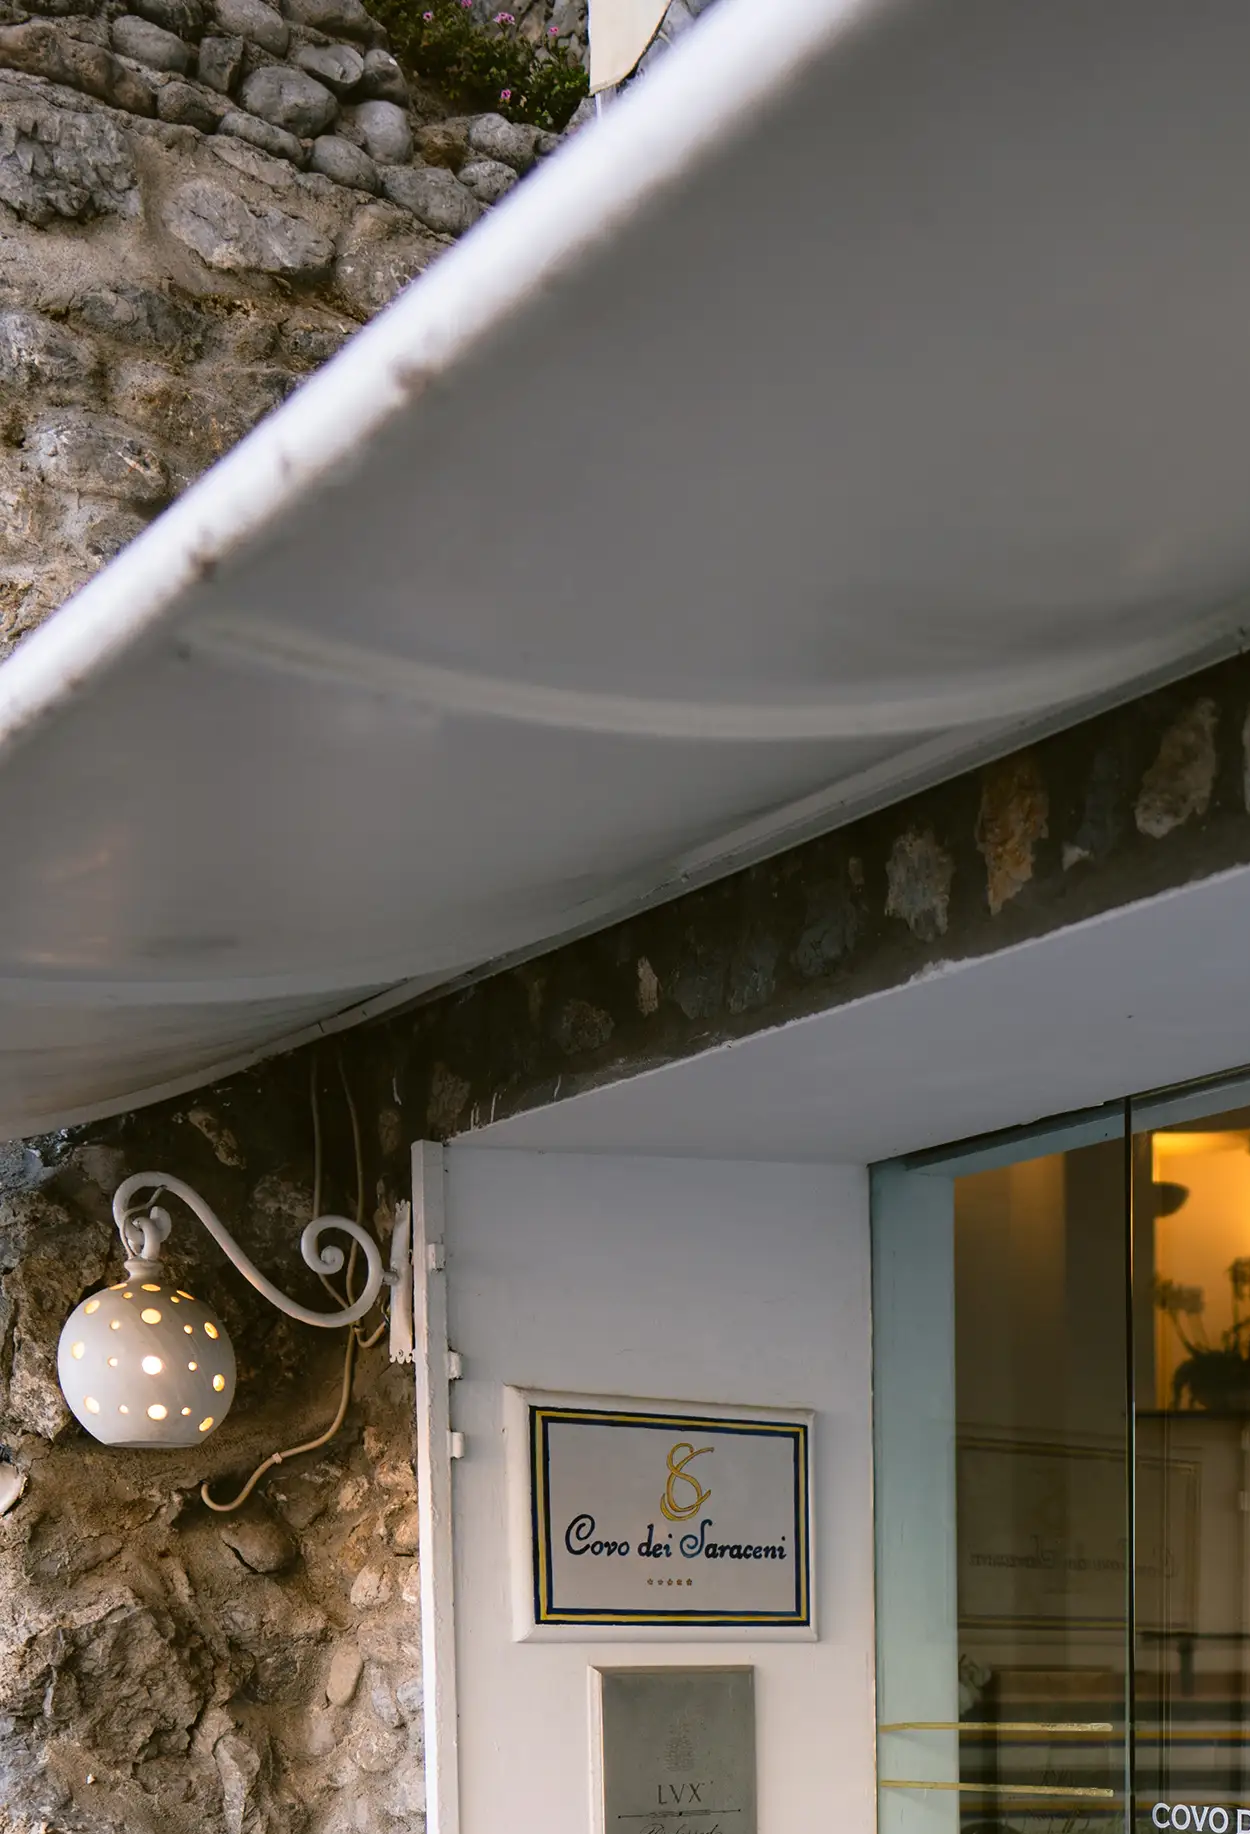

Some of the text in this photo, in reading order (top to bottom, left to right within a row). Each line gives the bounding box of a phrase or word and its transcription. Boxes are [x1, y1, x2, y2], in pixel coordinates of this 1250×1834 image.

[565, 1514, 787, 1560] Covo dei Saraceni
[657, 1783, 702, 1805] LVX
[1152, 1802, 1229, 1834] COVO
